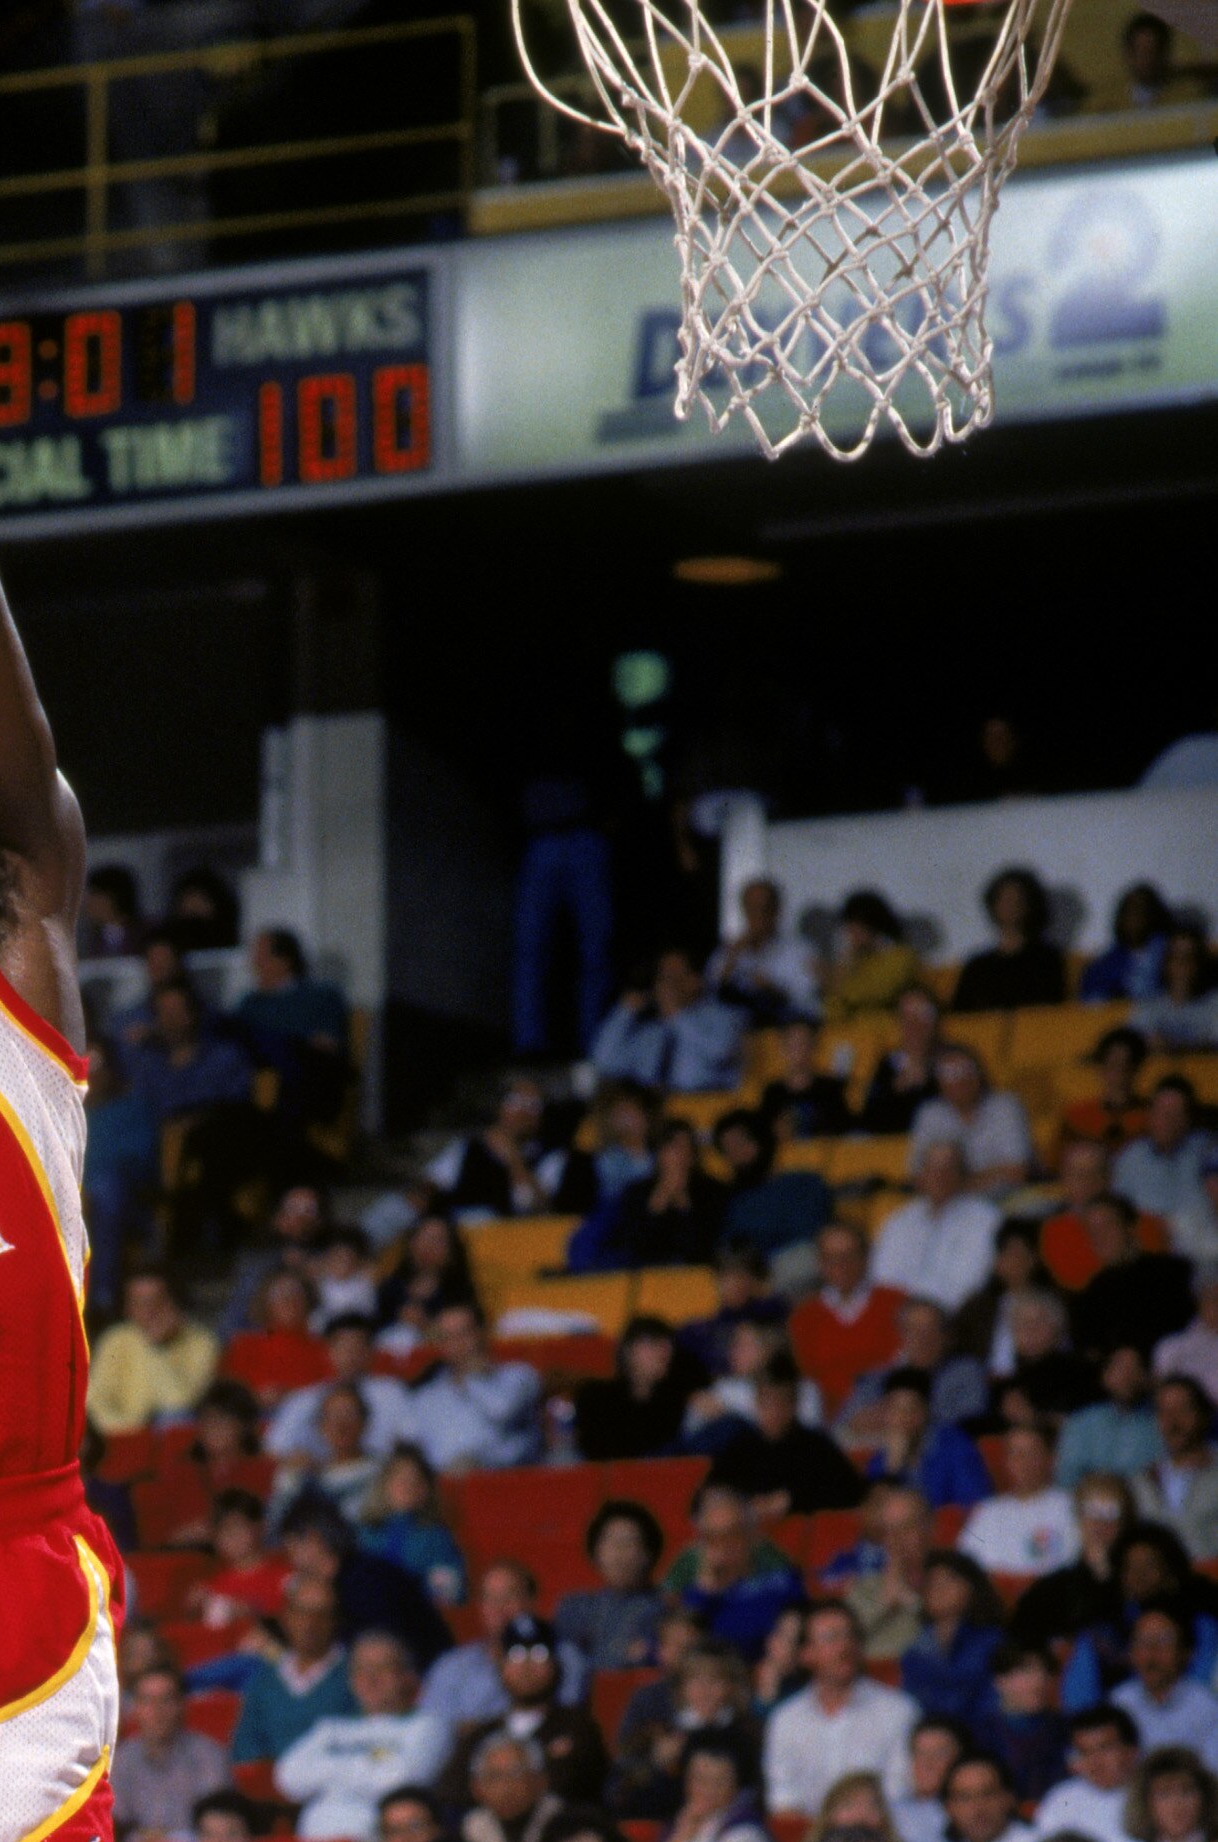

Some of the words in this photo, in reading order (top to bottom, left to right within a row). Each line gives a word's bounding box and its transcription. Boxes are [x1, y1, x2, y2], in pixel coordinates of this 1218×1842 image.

[212, 282, 422, 367] HAWKS
[98, 415, 234, 492] TIME
[259, 363, 430, 488] 100
